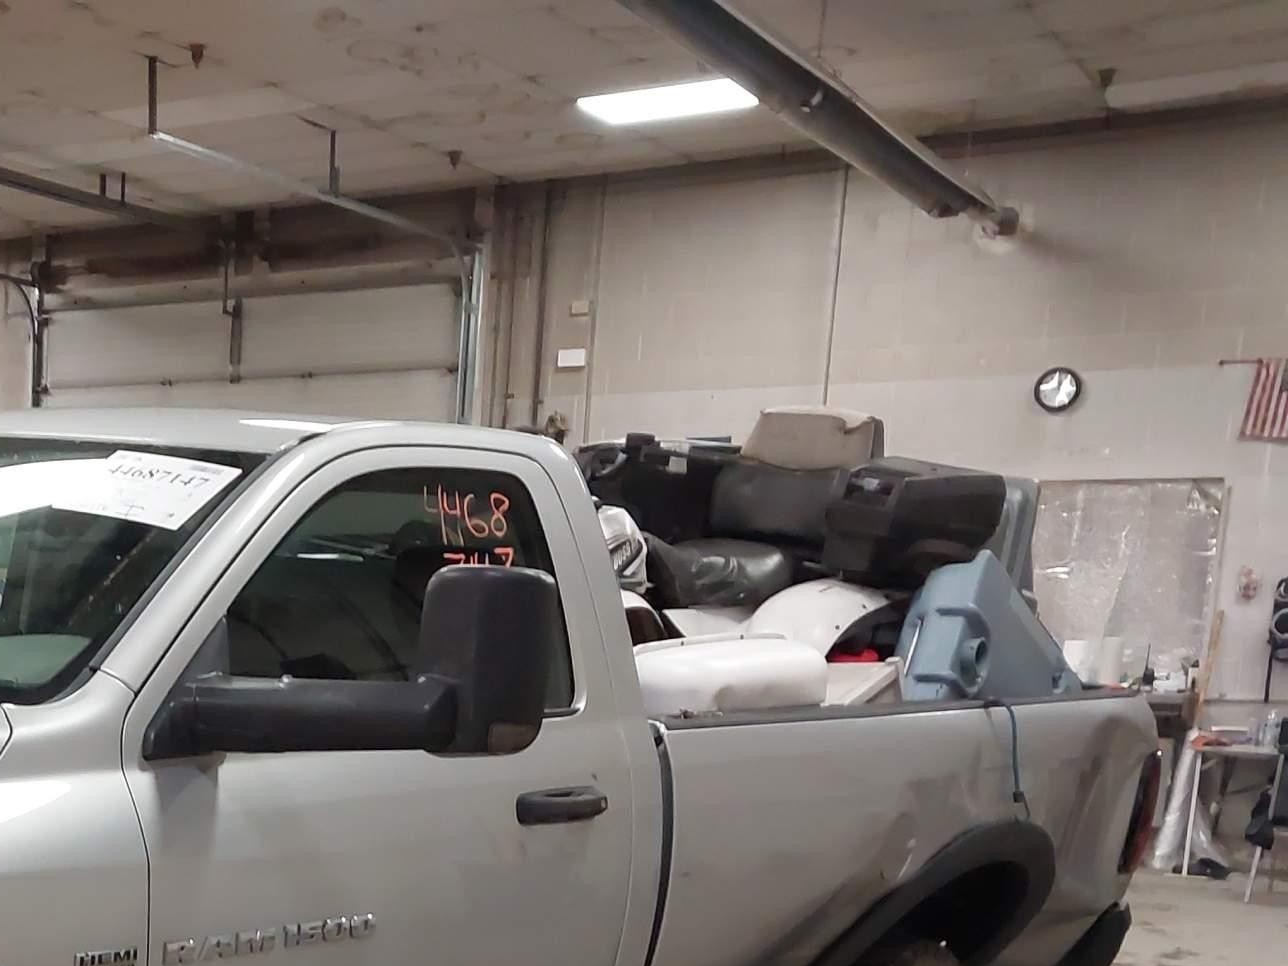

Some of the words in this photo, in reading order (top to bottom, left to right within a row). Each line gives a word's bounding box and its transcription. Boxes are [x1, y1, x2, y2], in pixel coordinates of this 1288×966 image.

[423, 483, 510, 547] 4468
[78, 948, 138, 966] HEMI
[162, 927, 276, 966] RAM
[282, 912, 377, 948] 1500
